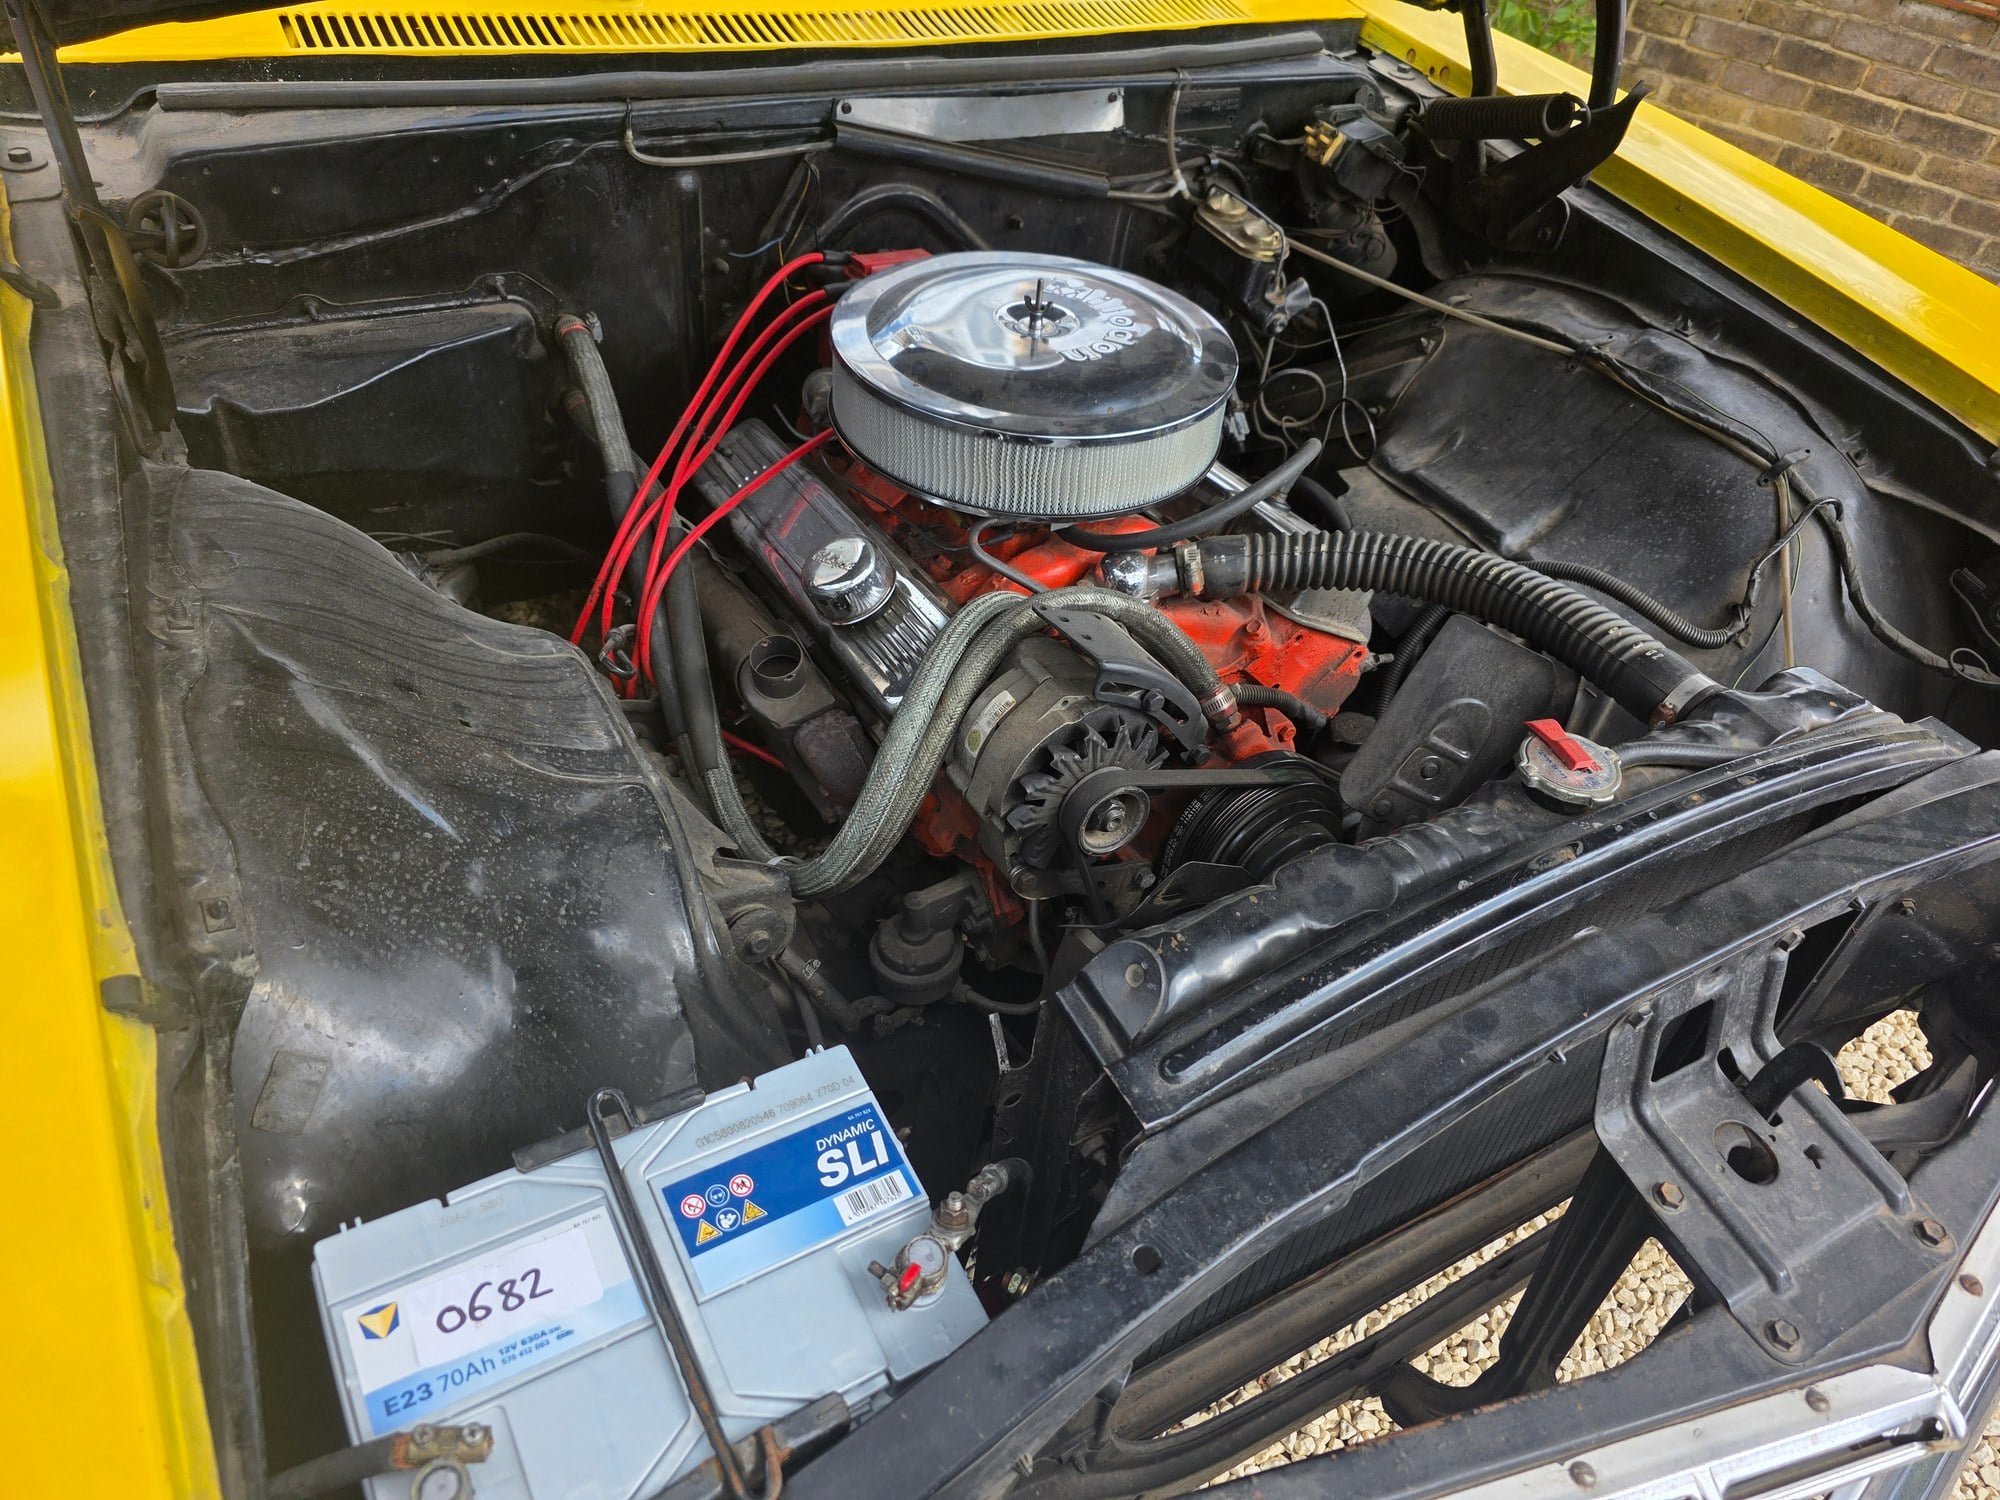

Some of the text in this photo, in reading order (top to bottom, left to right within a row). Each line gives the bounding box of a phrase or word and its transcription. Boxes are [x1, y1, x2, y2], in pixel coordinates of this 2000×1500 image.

[815, 1118, 876, 1152] DYNAMIC
[816, 1129, 890, 1188] SLI
[436, 1268, 554, 1333] 0682
[498, 1341, 518, 1356] 12V
[520, 1330, 548, 1348] 630A
[383, 1356, 497, 1417] E23 70Ah
